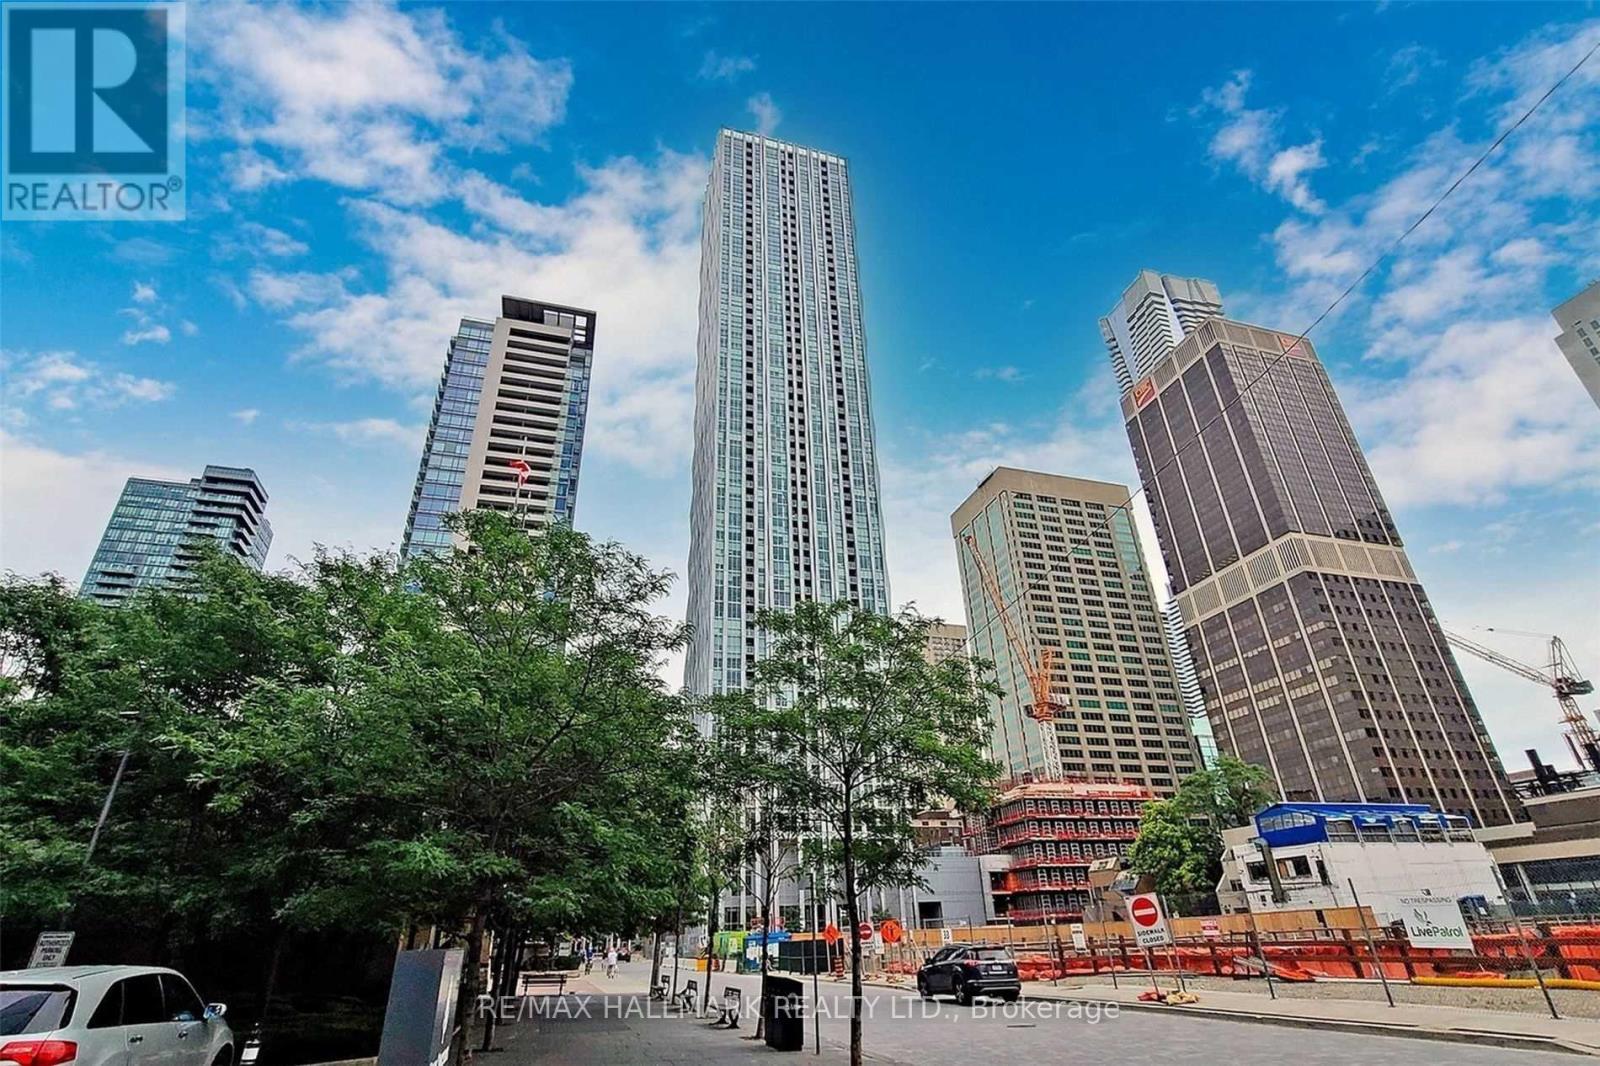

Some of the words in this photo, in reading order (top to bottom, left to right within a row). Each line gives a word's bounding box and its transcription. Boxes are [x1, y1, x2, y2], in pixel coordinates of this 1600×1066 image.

[1410, 896, 1452, 904] TRESPASSING
[1137, 928, 1165, 937] SIDEWALK
[1410, 926, 1464, 937] LivePatrol
[1142, 936, 1165, 944] CLOSED
